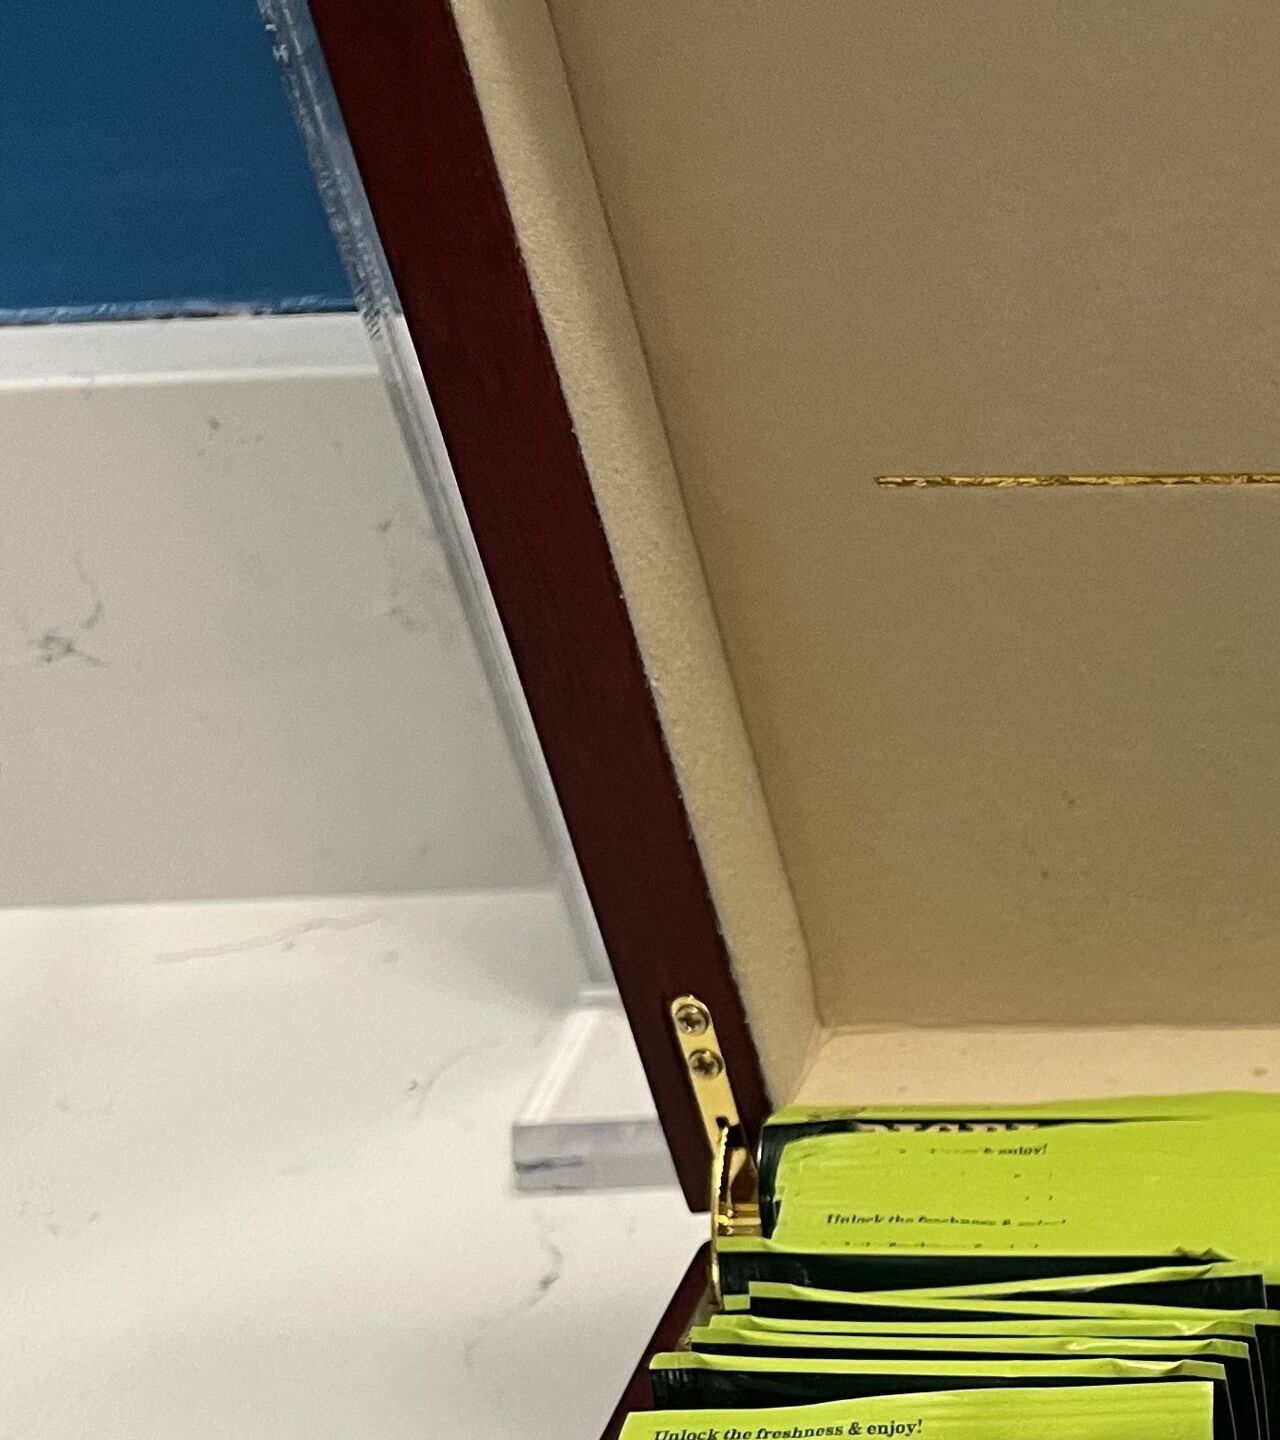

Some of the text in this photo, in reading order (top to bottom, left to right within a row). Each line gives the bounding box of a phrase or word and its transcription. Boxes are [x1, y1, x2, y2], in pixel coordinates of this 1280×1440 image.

[724, 1419, 923, 1440] the freshness & enjoy!
